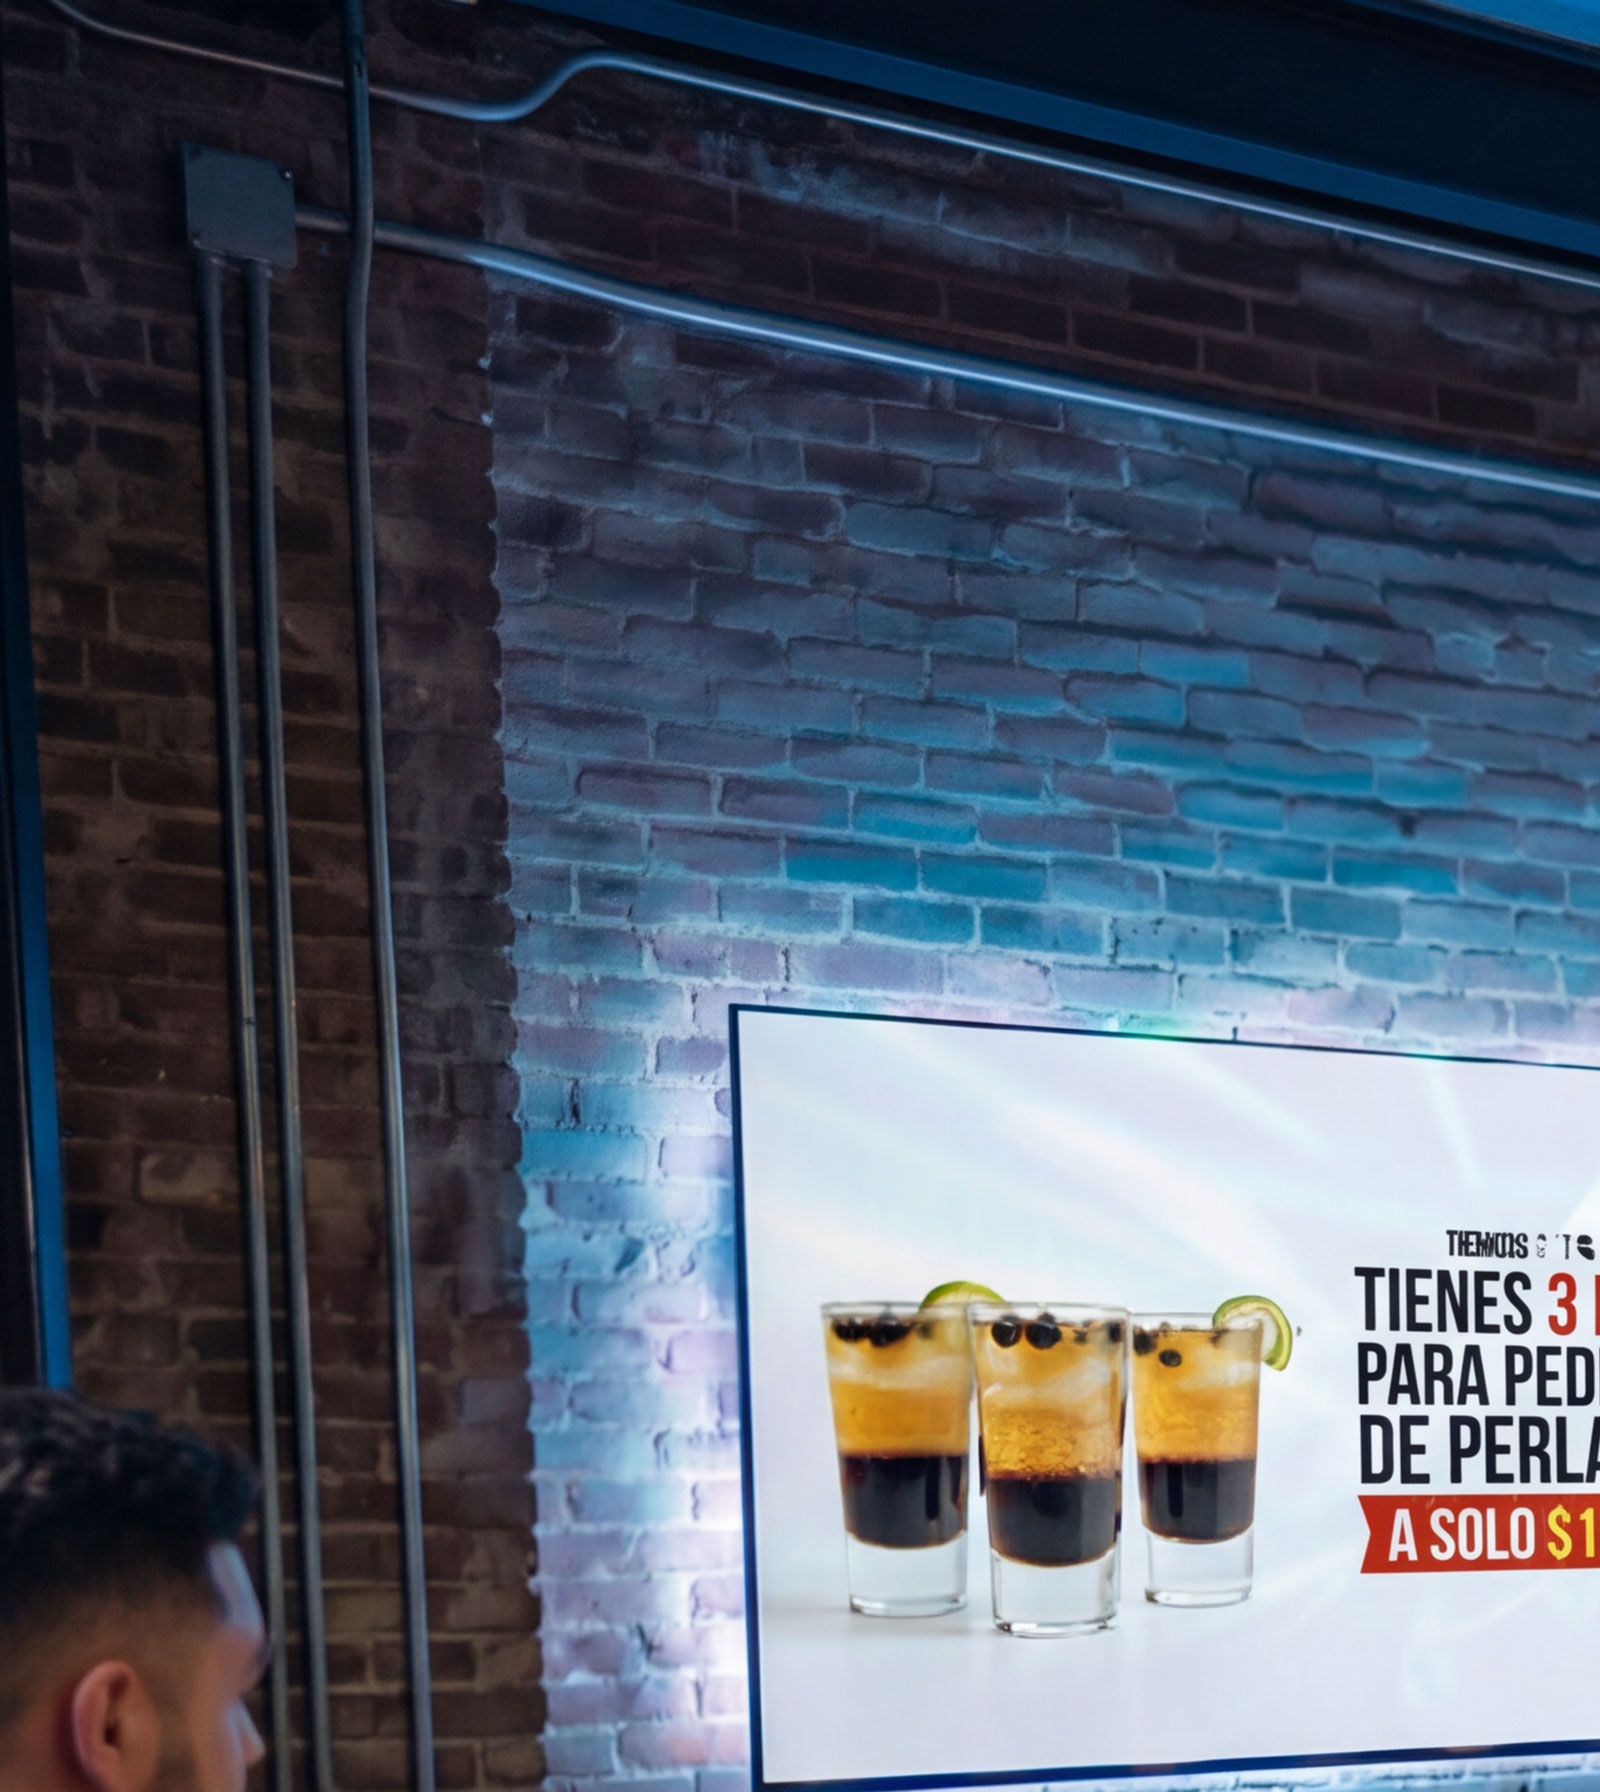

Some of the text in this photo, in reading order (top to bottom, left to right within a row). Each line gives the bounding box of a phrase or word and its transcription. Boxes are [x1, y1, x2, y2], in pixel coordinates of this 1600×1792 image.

[1354, 1266, 1533, 1335] TIENES
[1548, 1272, 1577, 1337] 3
[1357, 1342, 1490, 1406] PARA
[1359, 1414, 1431, 1485] DE
[1388, 1508, 1418, 1561] A
[1430, 1508, 1535, 1560] SOLO
